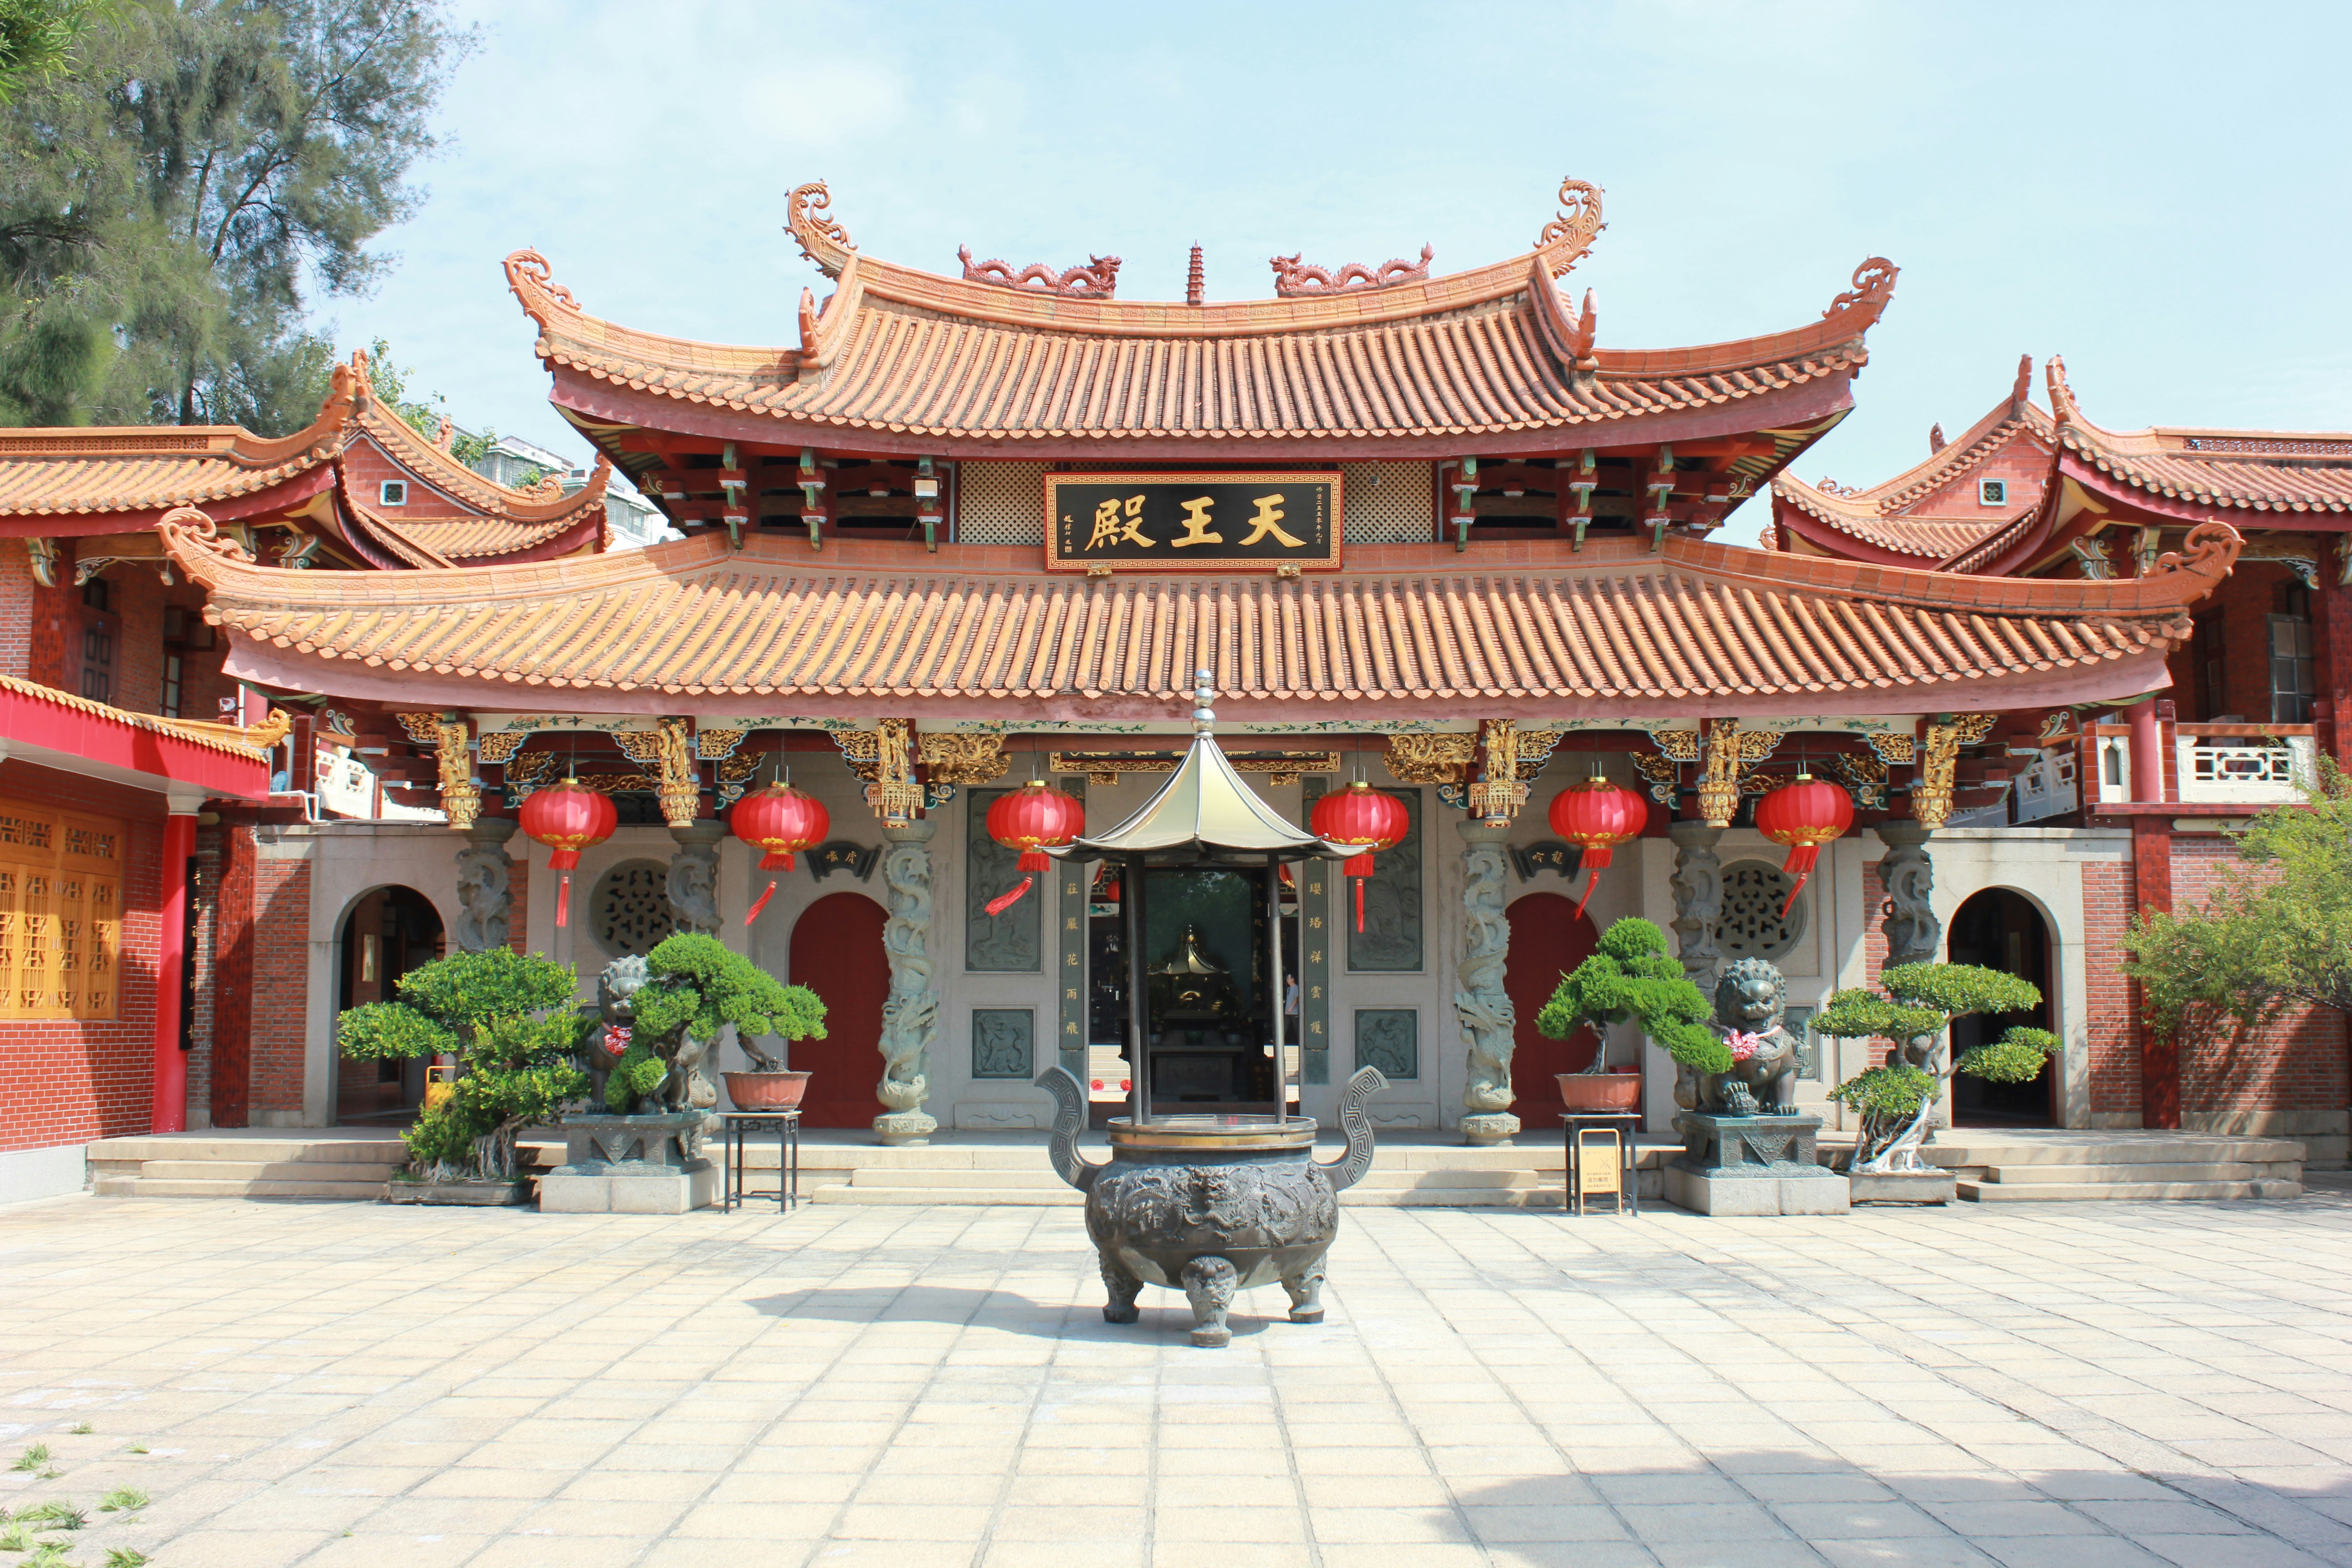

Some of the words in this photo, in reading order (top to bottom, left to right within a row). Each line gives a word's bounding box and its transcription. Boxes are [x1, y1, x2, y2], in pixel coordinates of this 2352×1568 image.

[1085, 494, 1307, 551] 天王殿
[1309, 856, 1323, 1034] 瓔珞祥雲護
